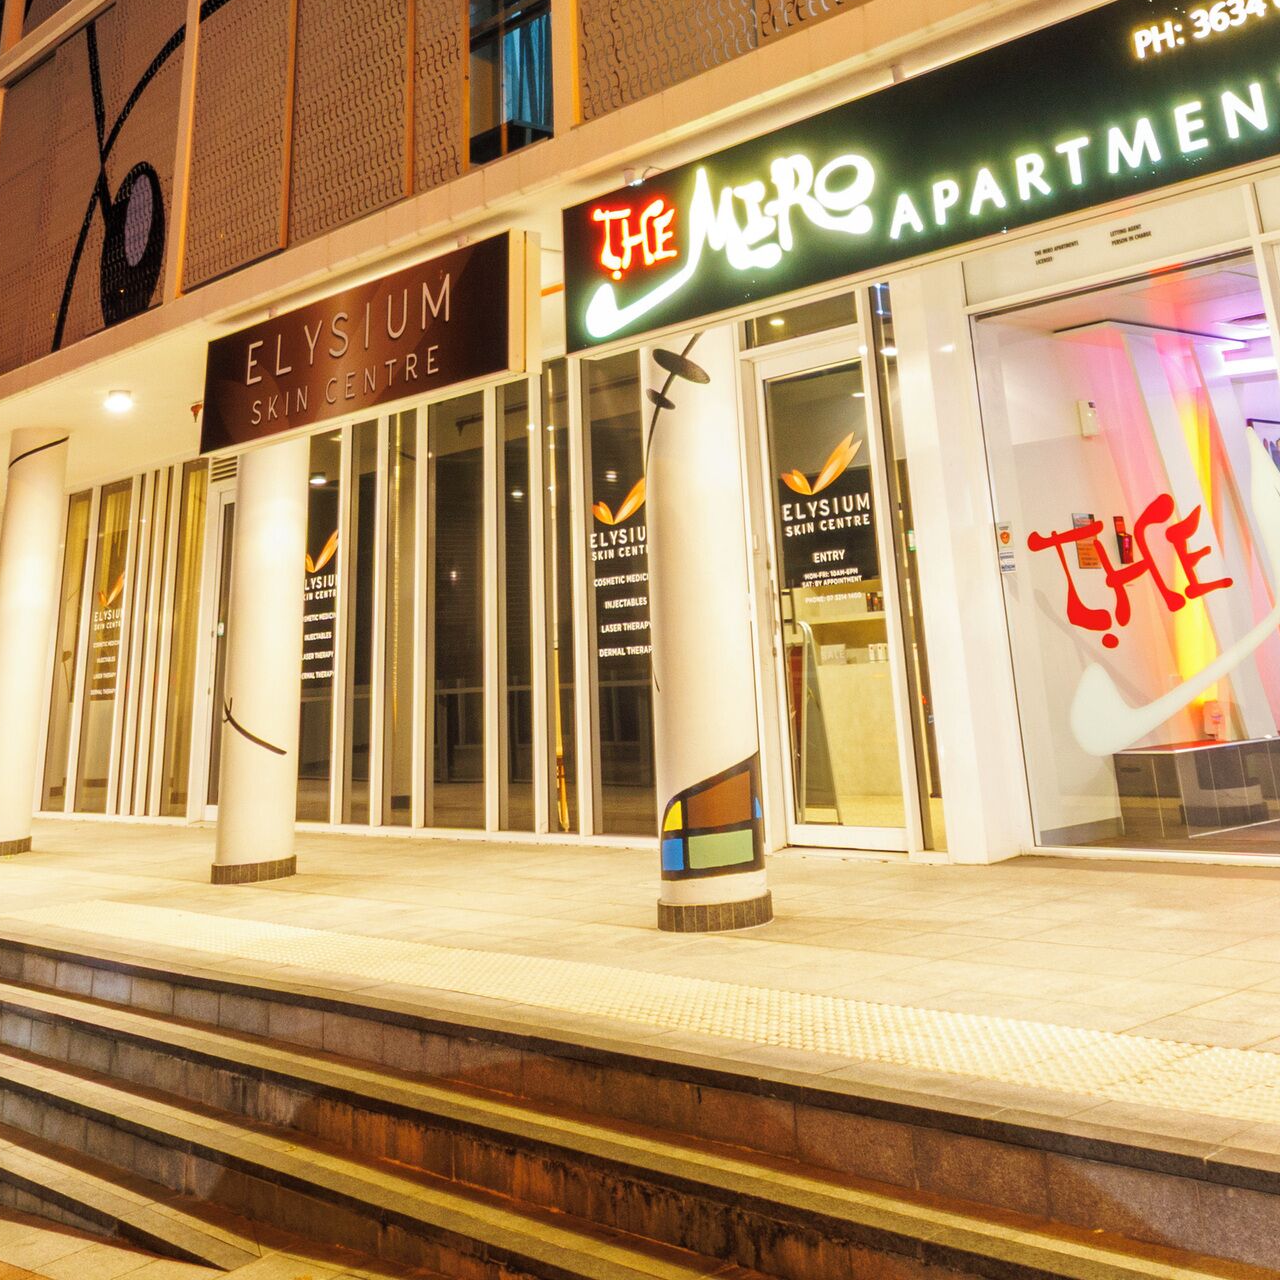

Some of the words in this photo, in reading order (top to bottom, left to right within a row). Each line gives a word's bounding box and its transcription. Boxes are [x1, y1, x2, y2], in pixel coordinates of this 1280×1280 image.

[1133, 21, 1185, 59] PH:
[585, 153, 875, 338] MIRO
[593, 199, 678, 280] THE
[246, 273, 450, 386] ELYSIUM
[250, 385, 308, 425] SKIN
[325, 344, 440, 404] CENTRE
[782, 492, 871, 522] ELYSIUM
[785, 522, 815, 537] SKIN
[820, 513, 871, 531] CENTRE
[590, 526, 647, 549] ELYSIU
[591, 549, 615, 561] SKIN
[618, 544, 648, 558] CENT
[813, 549, 845, 563] ENTRY
[1027, 493, 1234, 649] THE
[304, 574, 338, 591] LYSIU
[593, 576, 626, 588] COSMETIC
[315, 588, 337, 600] CENTR
[604, 597, 648, 610] INJECTABLES
[94, 609, 122, 623] ELYSIU
[601, 622, 622, 634] LASER
[598, 646, 626, 658] DERMAL
